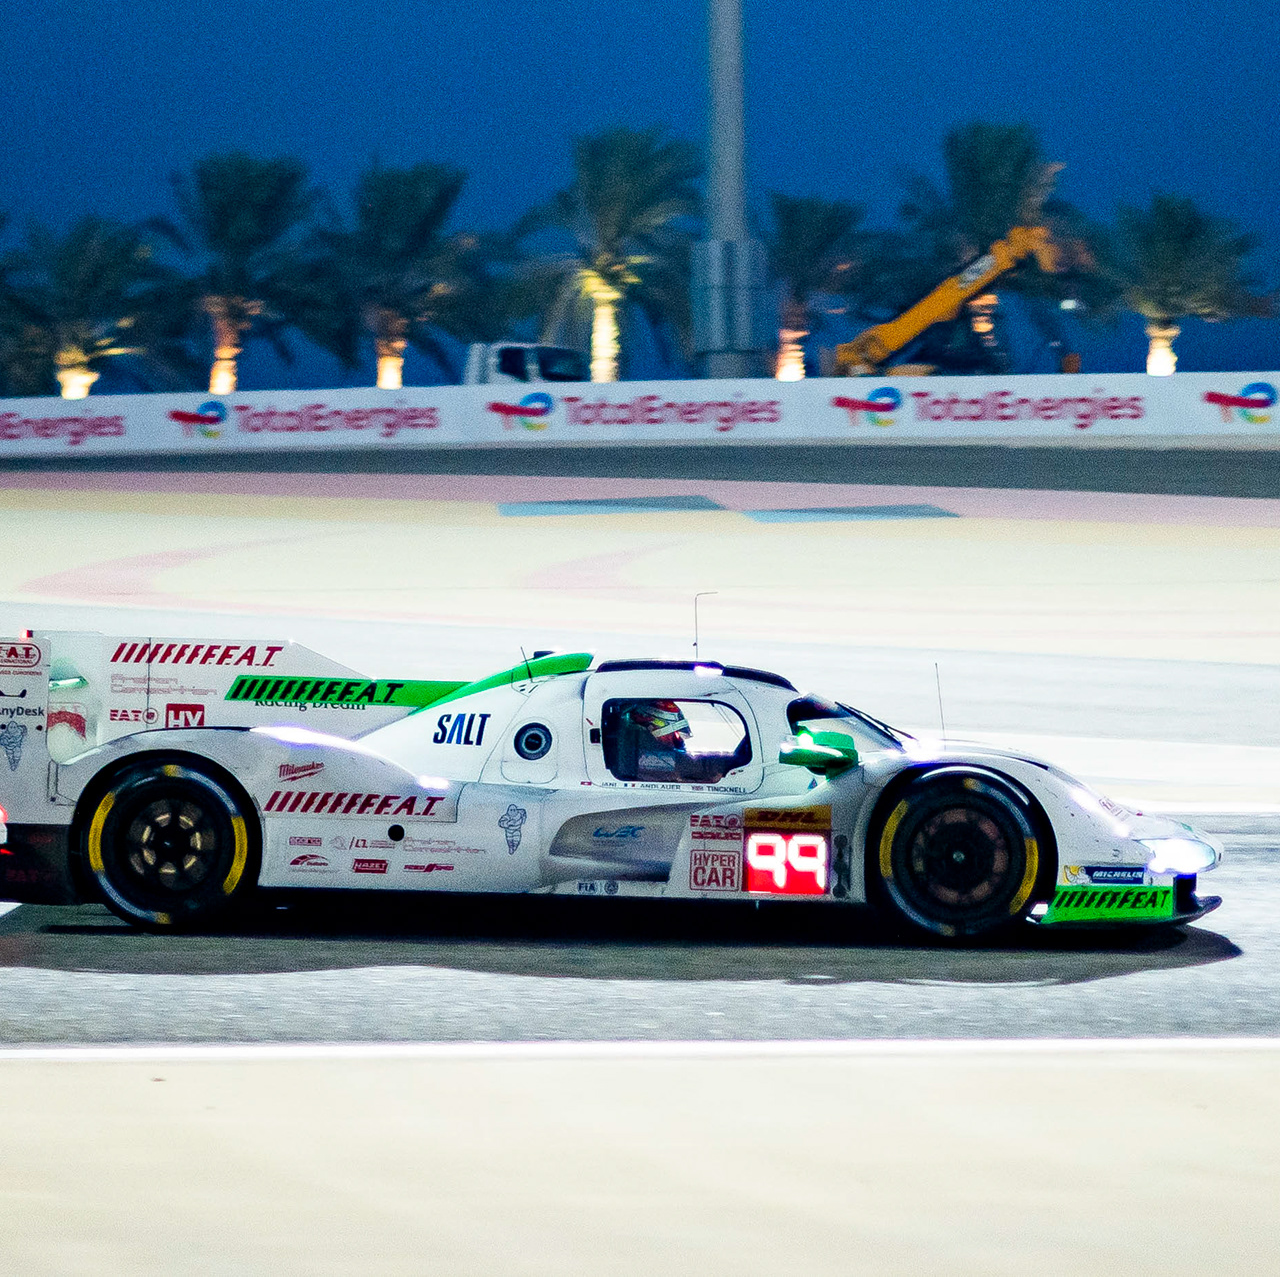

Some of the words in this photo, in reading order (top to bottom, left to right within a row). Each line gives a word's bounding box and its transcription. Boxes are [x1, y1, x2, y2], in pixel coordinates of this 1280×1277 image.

[234, 399, 440, 438] TotalEnergies
[563, 392, 780, 432] TotalEnergies
[910, 387, 1145, 429] TotalEnergies
[433, 713, 492, 746] SALT
[707, 786, 747, 794] TINCKNELL
[693, 853, 736, 867] HYPER
[747, 833, 826, 889] 99
[578, 882, 595, 892] FIA
[693, 867, 735, 888] CAR
[1092, 870, 1144, 878] MICHELIN
